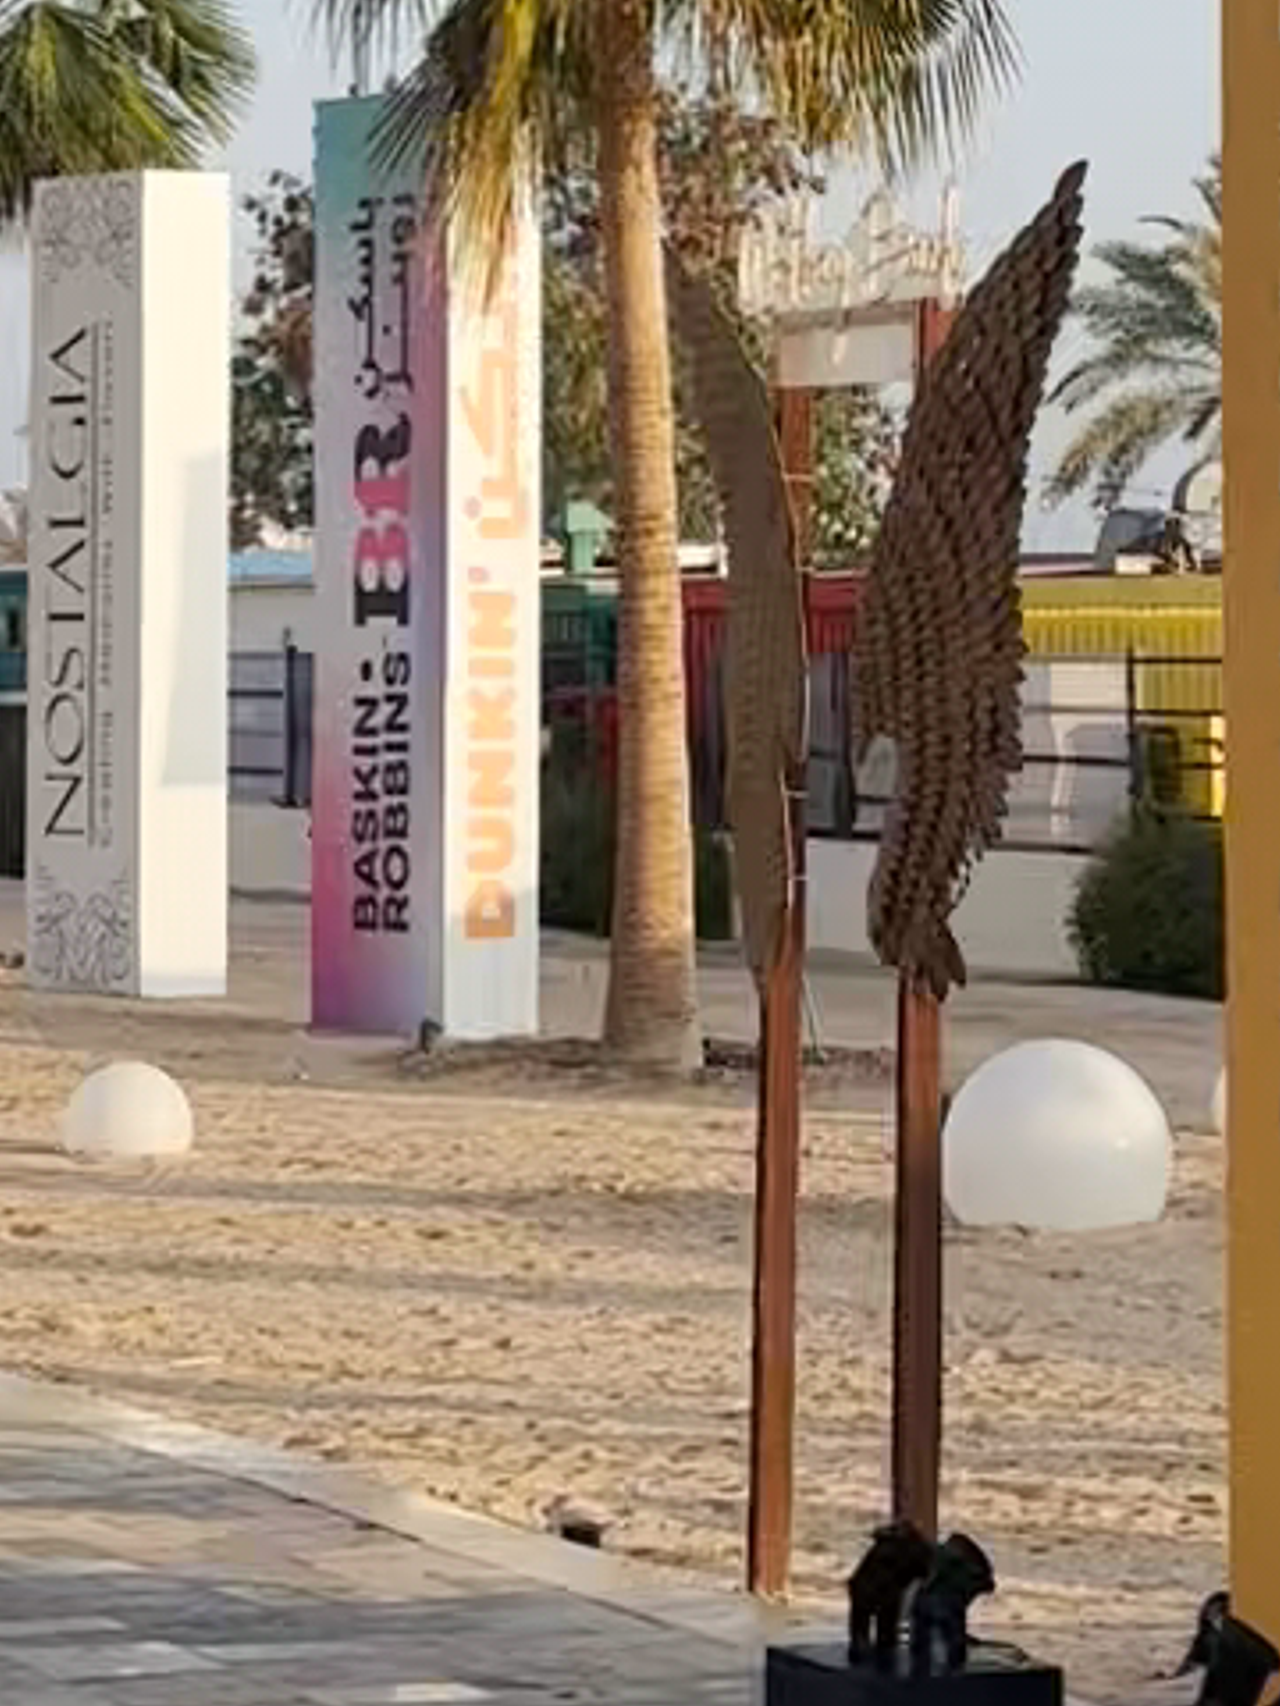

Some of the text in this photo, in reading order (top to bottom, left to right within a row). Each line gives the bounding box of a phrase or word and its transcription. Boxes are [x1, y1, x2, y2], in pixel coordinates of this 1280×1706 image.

[348, 198, 384, 399] باسكن
[45, 328, 86, 838] NOSTALGIA
[354, 413, 411, 627] BR
[352, 698, 380, 933] BASKIN
[382, 652, 410, 933] ROBBINS
[464, 566, 516, 941] DUNKIN'
